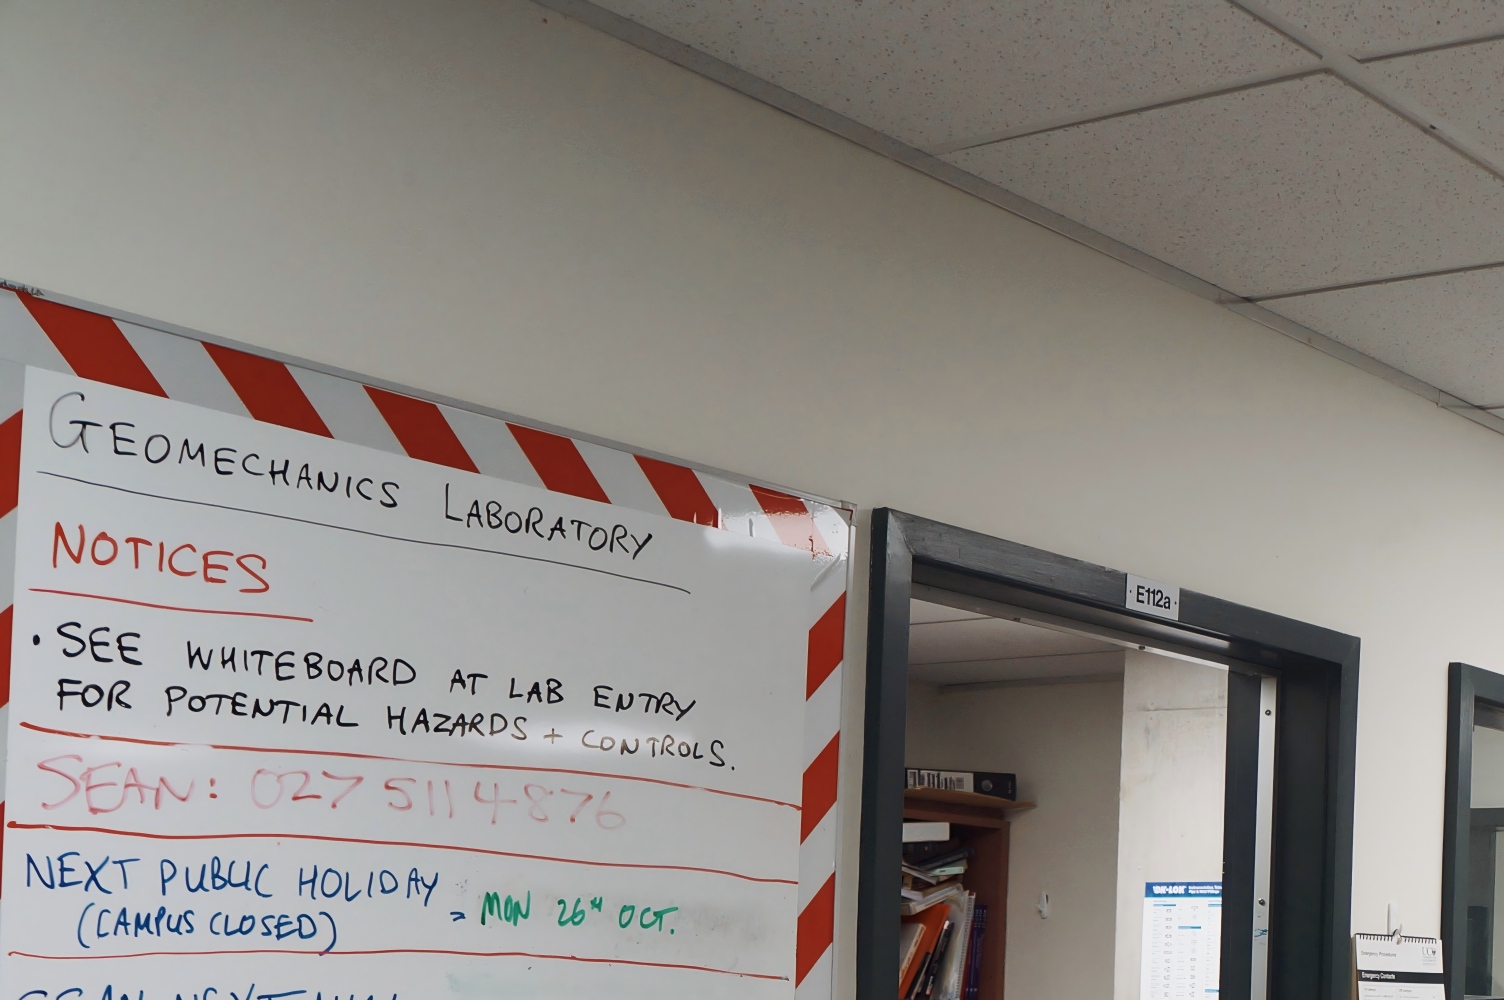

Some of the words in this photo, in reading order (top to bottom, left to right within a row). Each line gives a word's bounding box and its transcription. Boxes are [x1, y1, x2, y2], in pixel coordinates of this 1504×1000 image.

[49, 391, 400, 508] GEOMECHANICS
[445, 483, 653, 560] LABORATORY
[51, 521, 270, 593] NOTICES
[1136, 584, 1171, 609] E112a
[57, 622, 143, 666] SEE
[187, 641, 417, 686] WHITEBOARD
[450, 669, 488, 697] AT
[509, 677, 564, 704] LAB
[594, 685, 697, 721] ENTRY
[57, 679, 132, 711] FOR
[165, 686, 359, 727] POTENTIAL
[386, 706, 528, 742] HAZARDS
[581, 729, 737, 772] CONTROLS.
[37, 754, 218, 815] SEAN:
[26, 851, 141, 895] NEXT
[160, 856, 273, 898] PUBLIC
[298, 865, 439, 907] HOLIDAY
[480, 890, 531, 926] MON
[77, 902, 195, 948] (CAMPUS
[210, 911, 337, 956] CLOSED)
